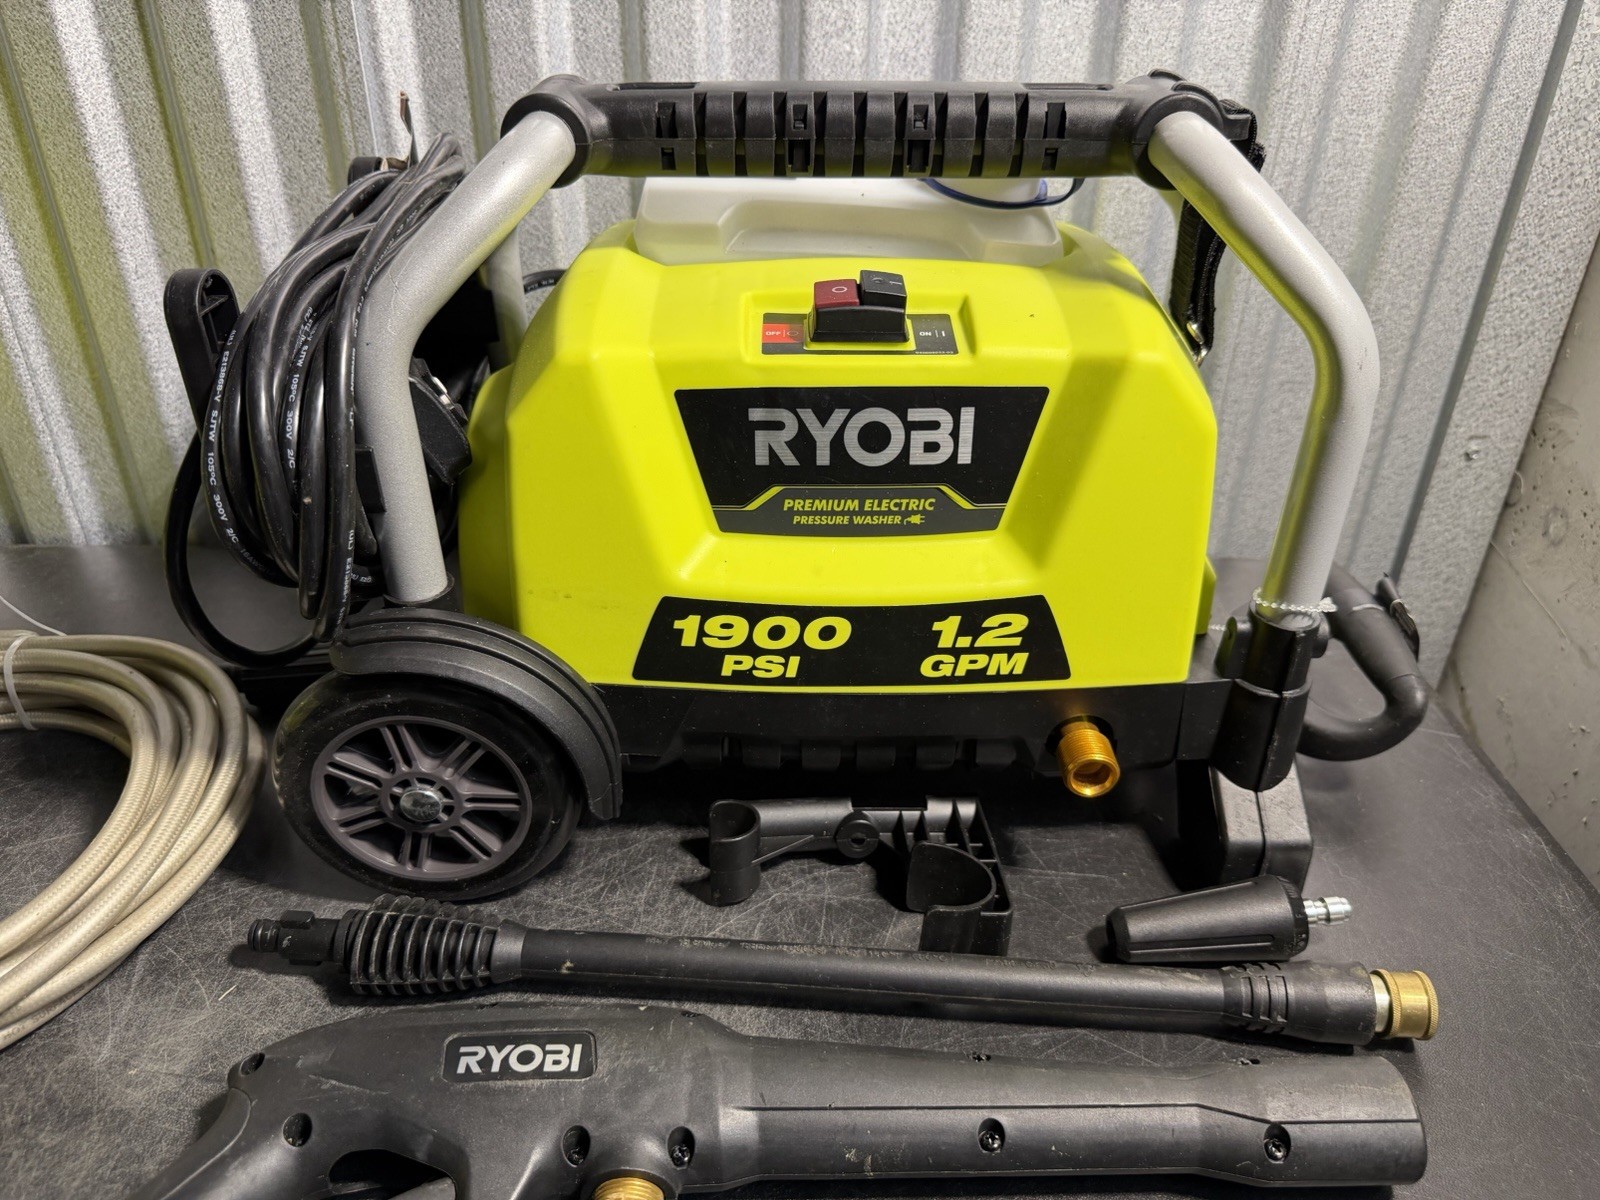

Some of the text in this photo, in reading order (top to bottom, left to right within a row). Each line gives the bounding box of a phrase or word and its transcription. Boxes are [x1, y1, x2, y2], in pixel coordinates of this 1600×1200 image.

[297, 345, 309, 367] SJTW
[208, 410, 219, 442] SJTW
[285, 410, 294, 440] 300V
[747, 406, 976, 467] RYOBI
[287, 449, 296, 469] 2/C
[213, 494, 228, 521] 300V
[783, 498, 936, 512] PREMIUM ELECTRIC
[793, 515, 902, 525] PRESSURE WASHER
[225, 527, 239, 544] 2/C
[673, 614, 852, 650] 1900
[931, 613, 1029, 648] 1.2
[721, 654, 801, 678] PSI
[919, 652, 1029, 677] GPM
[456, 1043, 583, 1074] RYOBI
